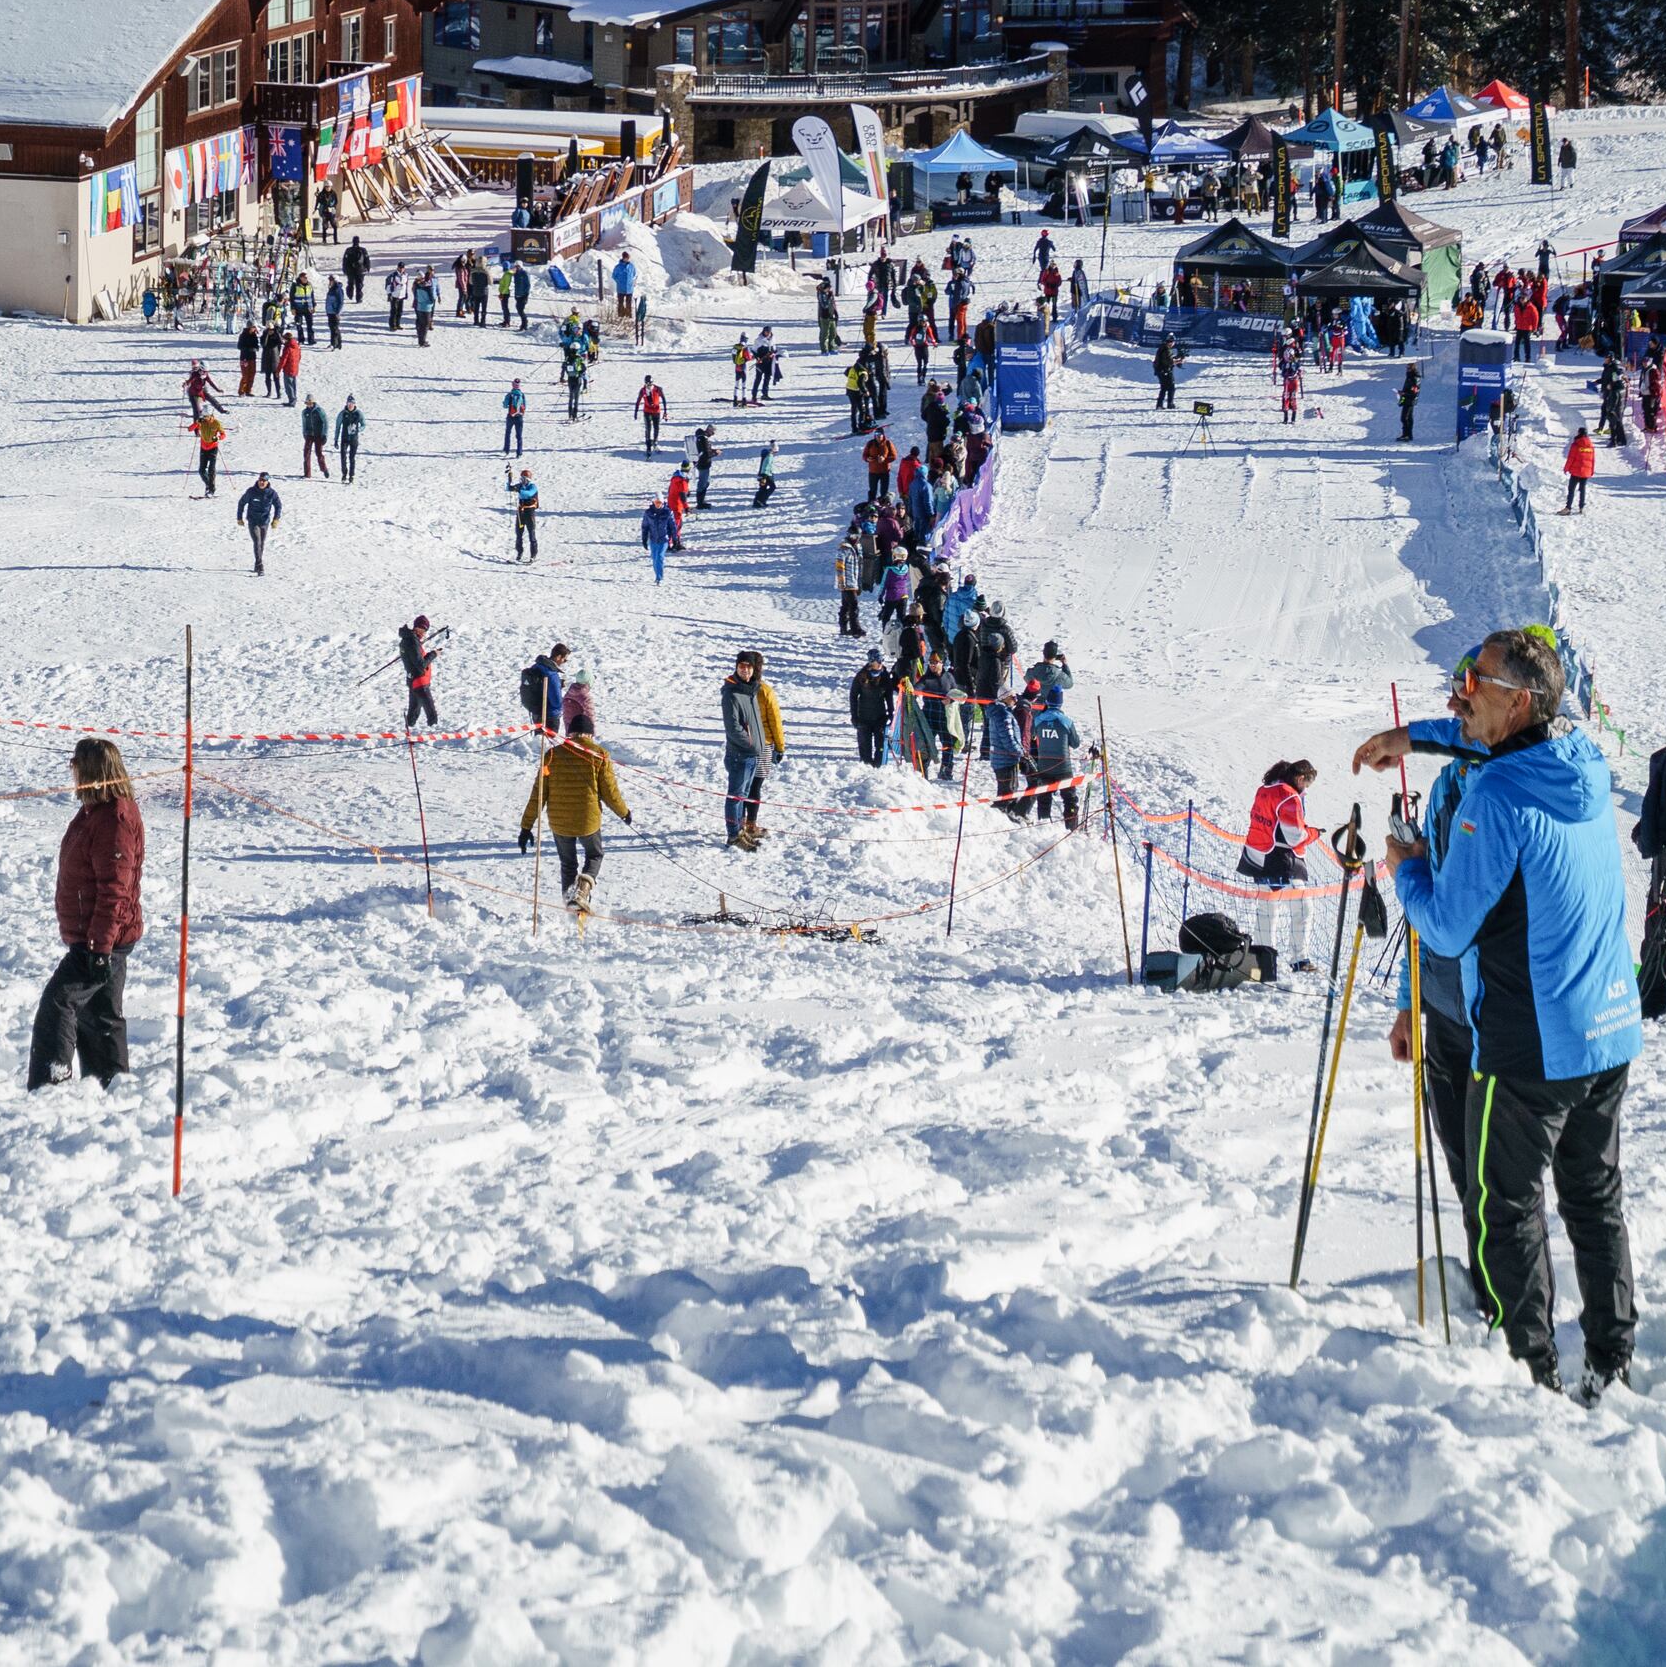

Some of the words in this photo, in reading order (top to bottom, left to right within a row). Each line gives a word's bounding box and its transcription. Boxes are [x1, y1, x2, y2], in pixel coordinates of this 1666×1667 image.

[1534, 102, 1545, 165] SPORTIVA
[1346, 139, 1374, 150] SCAR
[1277, 147, 1289, 214] SPORTIVA
[761, 219, 818, 228] DYNAFIT
[1364, 224, 1403, 233] SKYLINE
[1042, 729, 1059, 739] ITA
[1607, 979, 1629, 1001] AZE
[1594, 1004, 1630, 1025] NATIONAL
[1585, 1028, 1598, 1041] SKI
